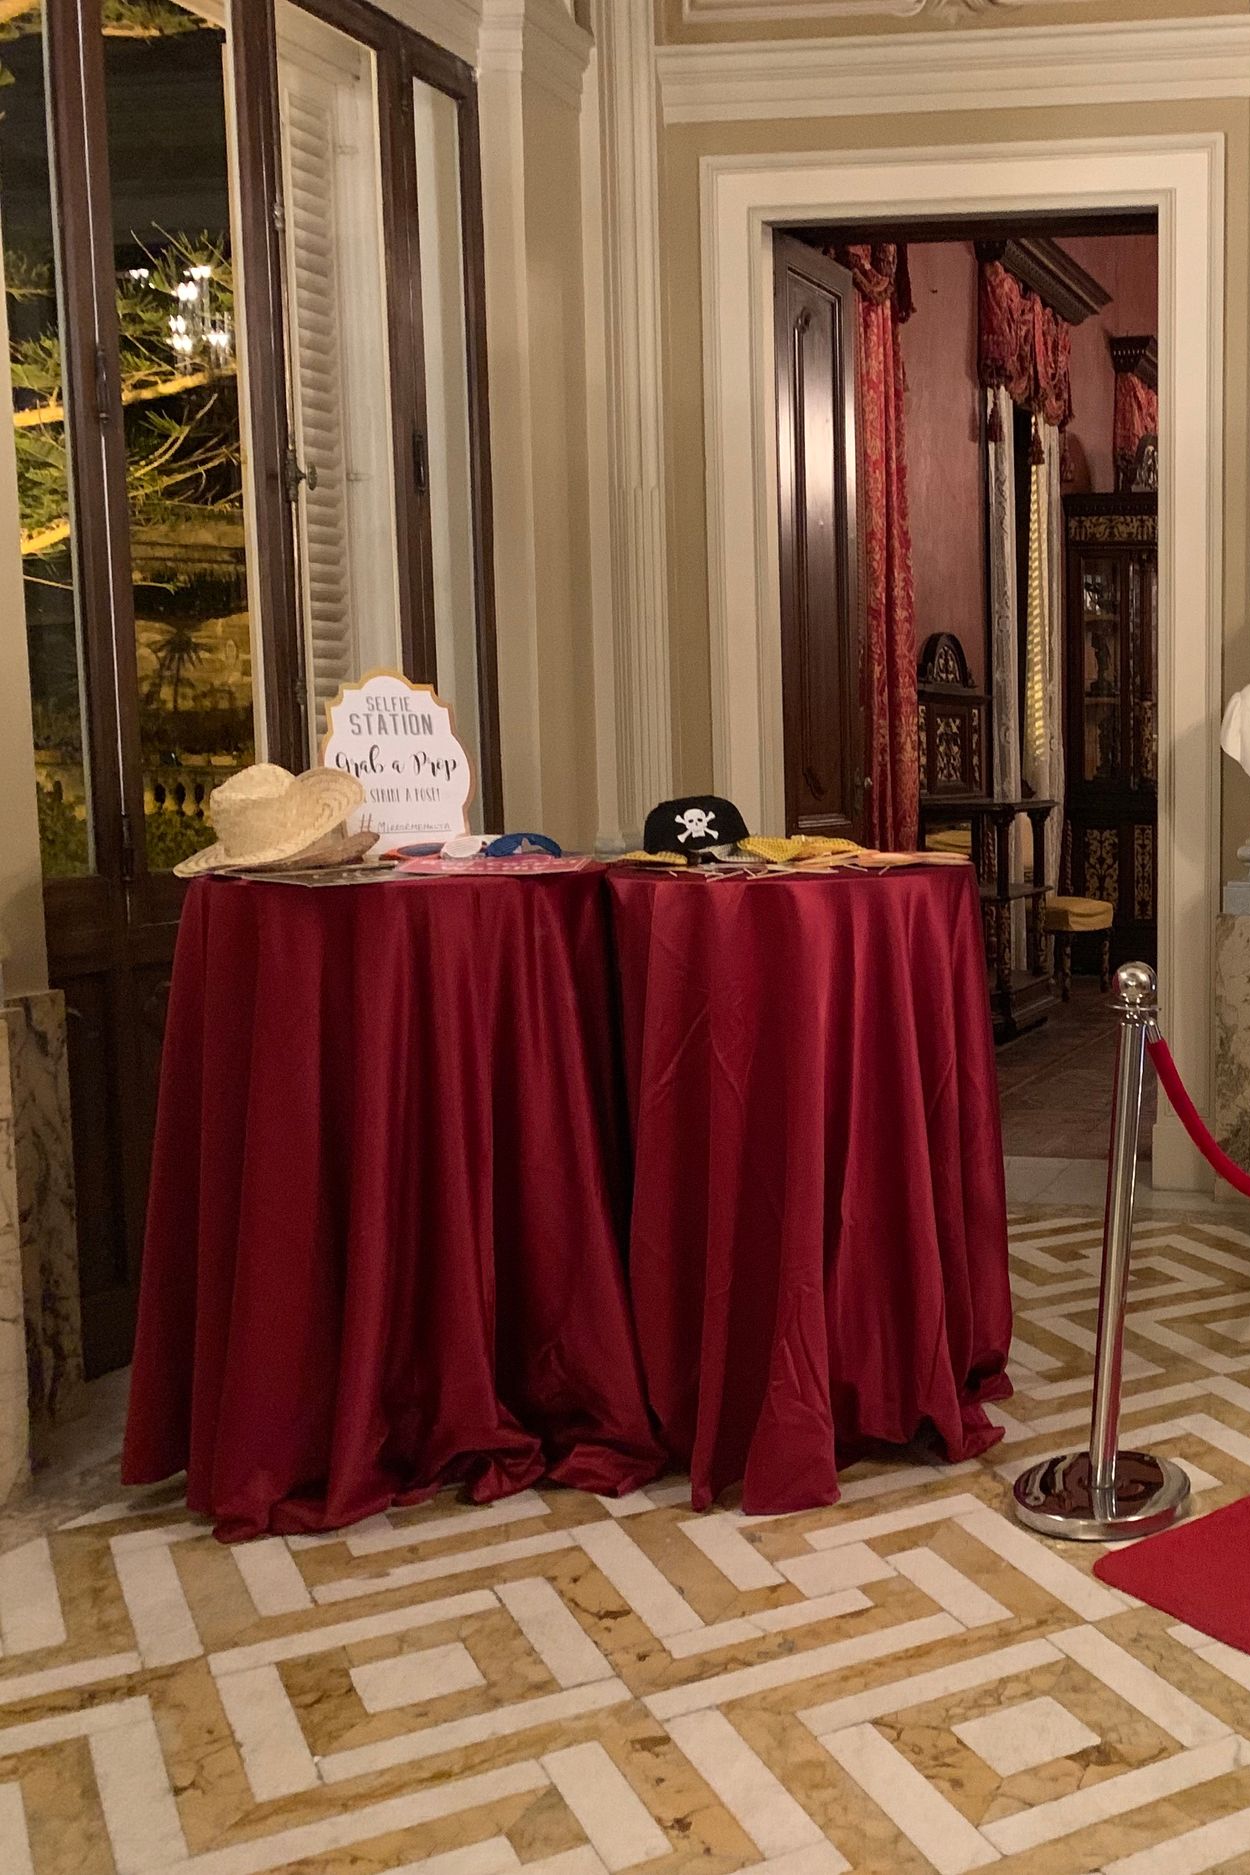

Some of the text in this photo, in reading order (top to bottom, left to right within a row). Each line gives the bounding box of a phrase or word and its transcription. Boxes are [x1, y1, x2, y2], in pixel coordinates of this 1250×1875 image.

[366, 696, 412, 712] SELFIE
[349, 713, 434, 736] STATION
[335, 744, 457, 781] Grab a Prop
